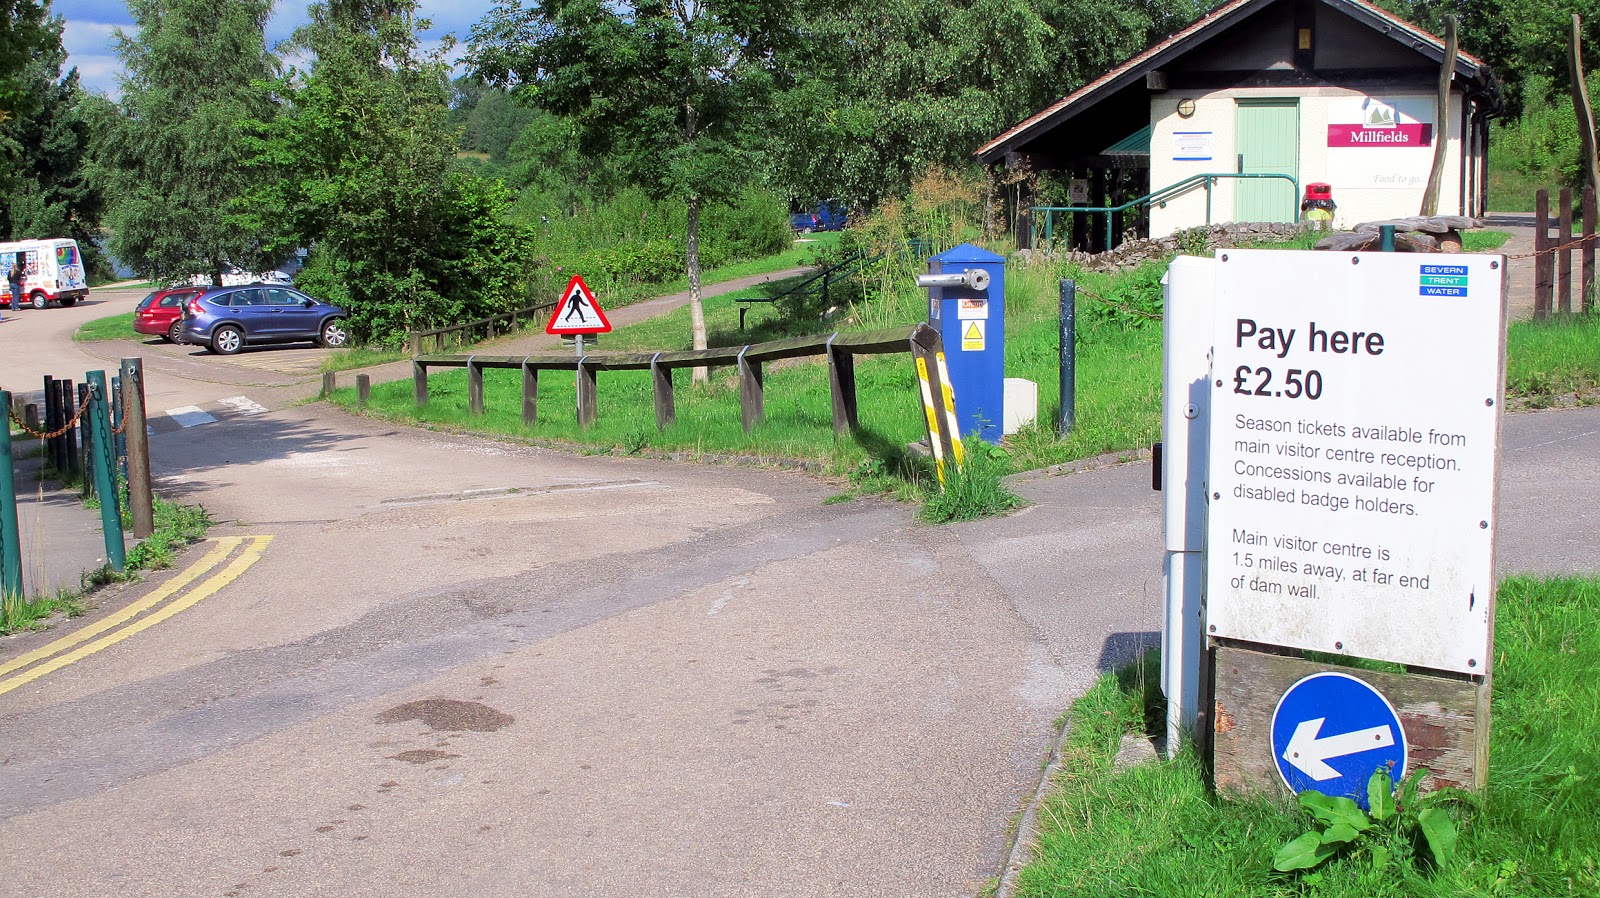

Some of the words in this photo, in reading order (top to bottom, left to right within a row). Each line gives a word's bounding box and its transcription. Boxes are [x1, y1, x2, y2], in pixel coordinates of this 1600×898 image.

[1350, 131, 1408, 143] Millfields
[1373, 173, 1397, 183] Food
[1398, 174, 1407, 183] to
[1425, 266, 1464, 274] SEVERN
[1237, 319, 1295, 358] Pay
[1309, 322, 1384, 355] here
[1234, 365, 1322, 400] £2.50
[1235, 414, 1291, 432] Season
[1298, 420, 1345, 437] tickets
[1352, 426, 1422, 443] available
[1429, 429, 1465, 446] from
[1235, 439, 1269, 453] main
[1276, 442, 1320, 458] visitor
[1326, 449, 1374, 463] centre
[1381, 454, 1460, 471] reception.
[1235, 460, 1331, 485] Concessions
[1338, 473, 1406, 490] available
[1413, 477, 1434, 492] for
[1234, 484, 1294, 503] disabled
[1302, 490, 1349, 511] badge
[1356, 496, 1417, 515] holders.
[1233, 529, 1267, 546] Main
[1274, 535, 1317, 551] visitor
[1323, 543, 1371, 558] centre
[1378, 546, 1389, 560] is
[1233, 552, 1253, 567] 1.5
[1259, 557, 1297, 573] miles
[1304, 564, 1345, 582] away,
[1353, 568, 1366, 582] at
[1373, 569, 1393, 584] far
[1400, 575, 1429, 589] end
[1231, 575, 1245, 588] of
[1250, 577, 1281, 594] dam
[1288, 584, 1319, 599] wall.
